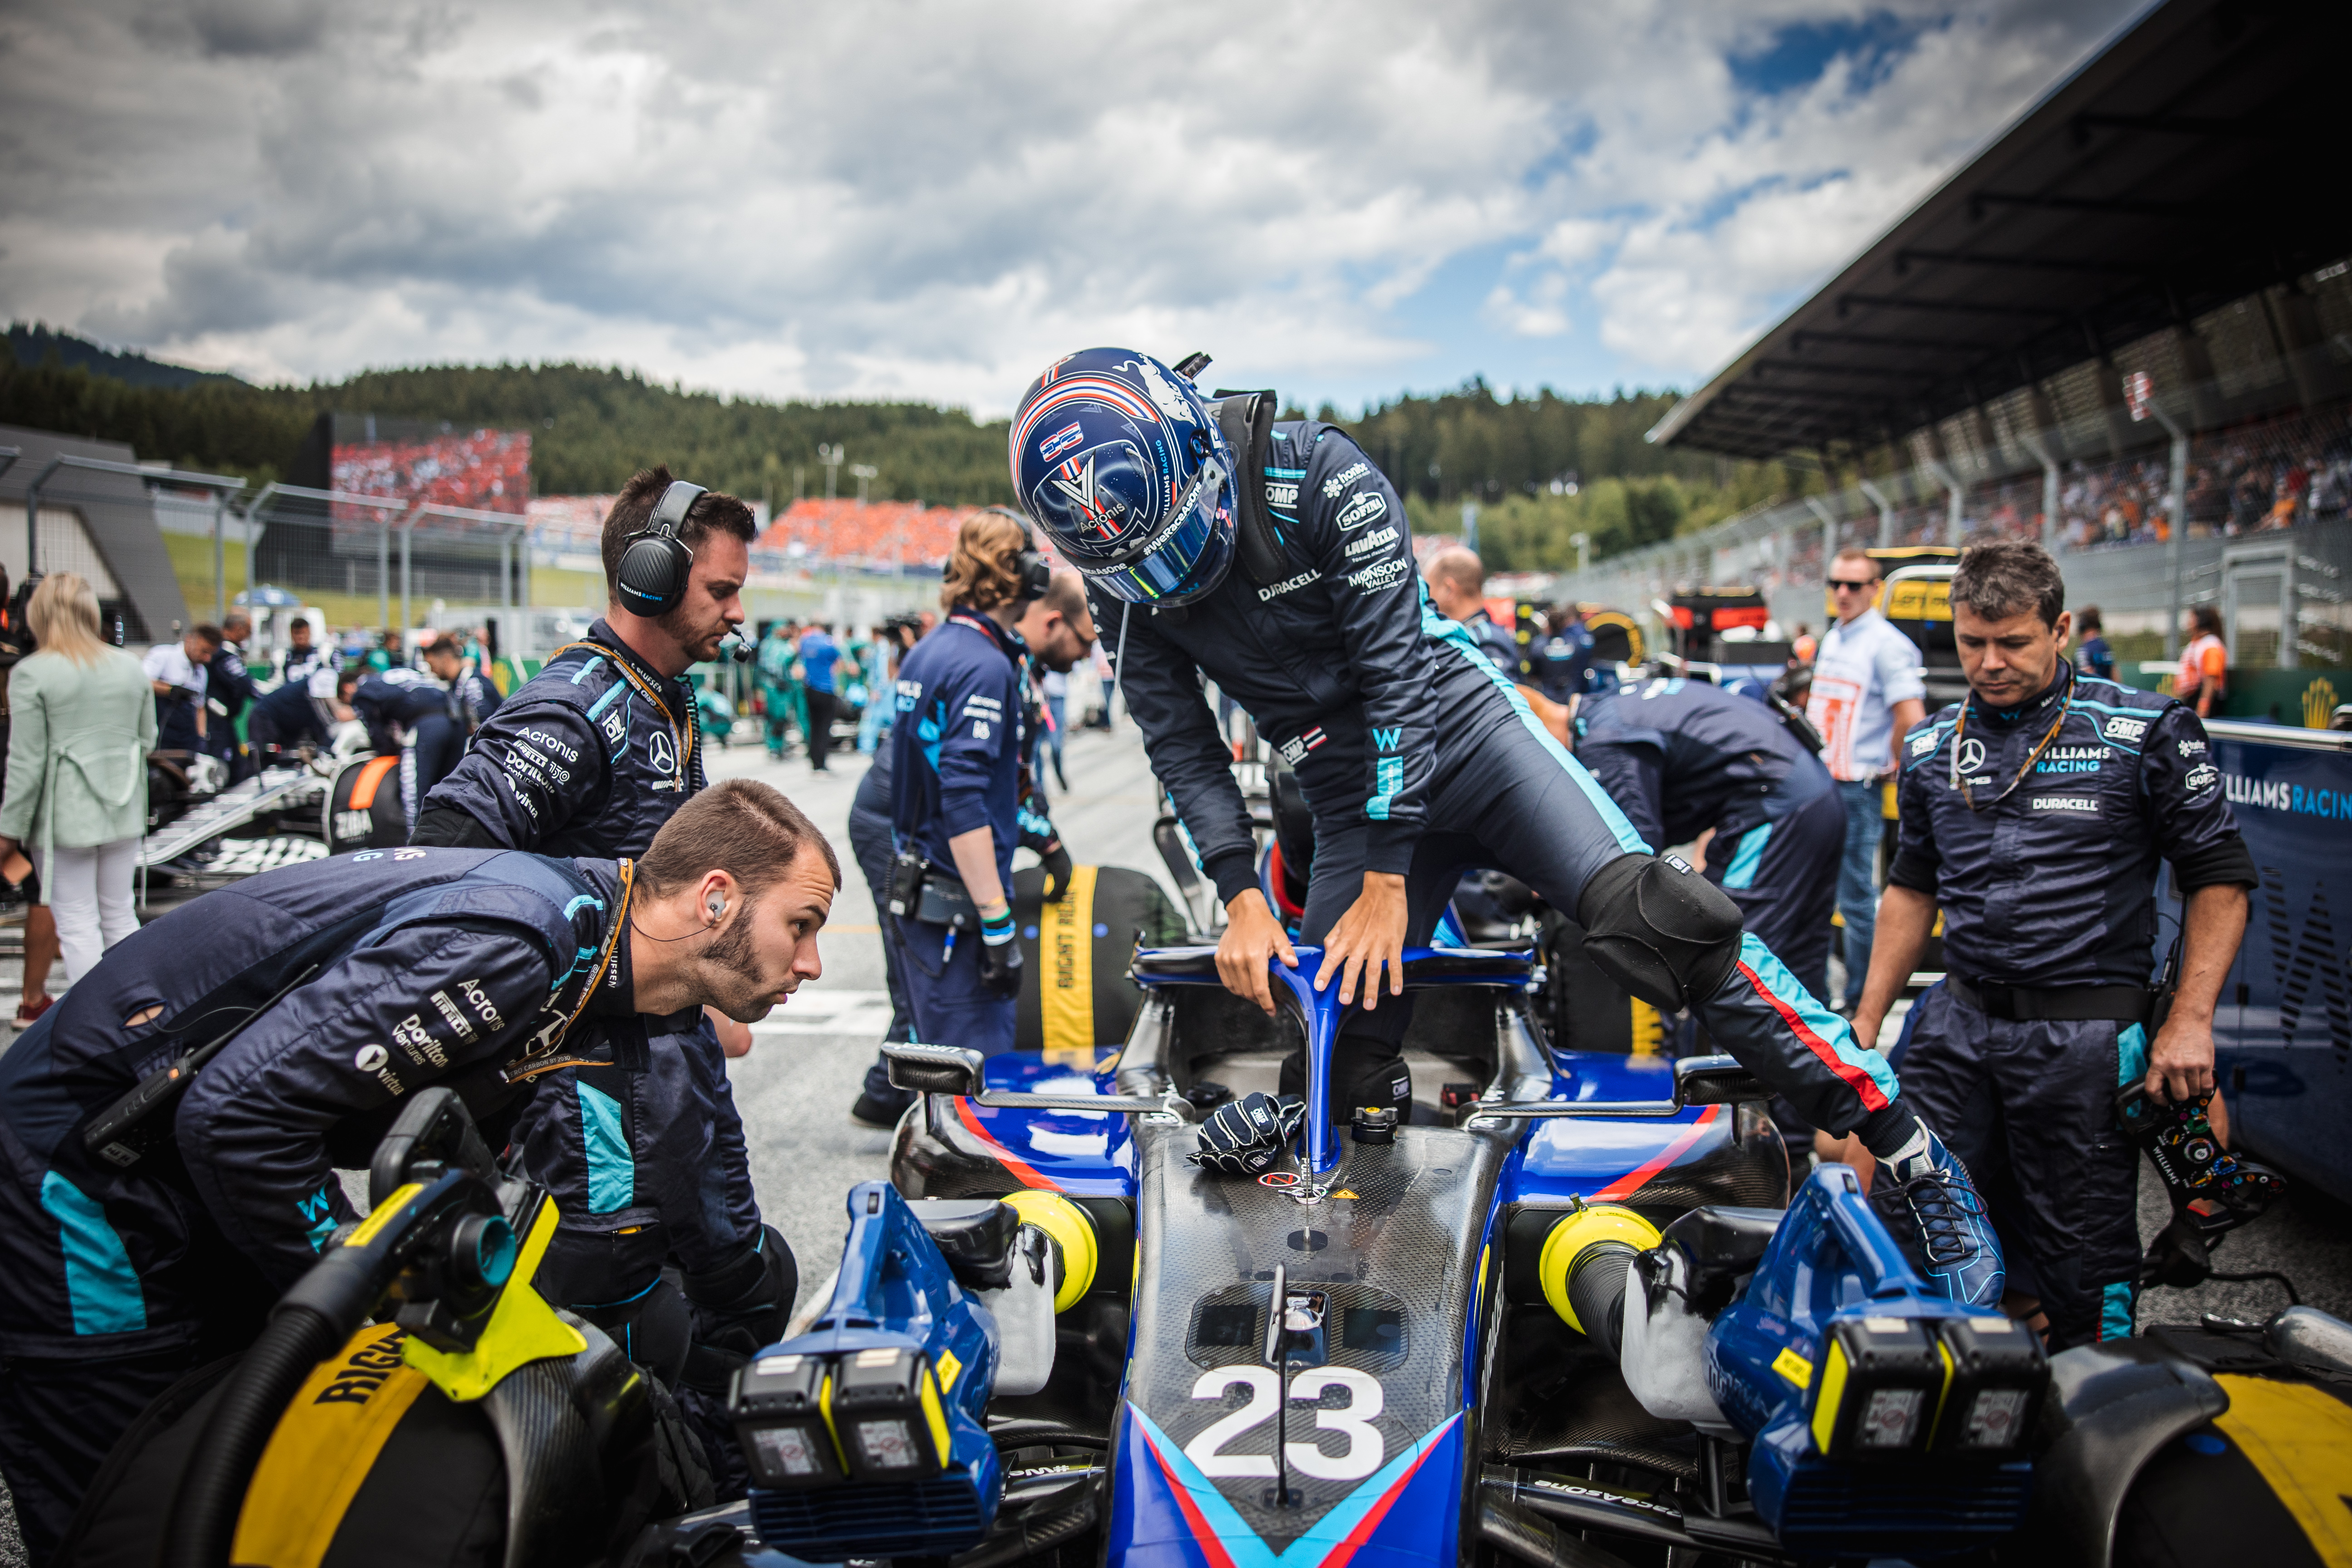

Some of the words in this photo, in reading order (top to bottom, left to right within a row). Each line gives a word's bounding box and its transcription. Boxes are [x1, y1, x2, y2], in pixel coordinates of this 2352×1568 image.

[1039, 419, 1084, 463] 23
[1155, 439, 1169, 474] RACING
[1265, 487, 1298, 504] OMP
[1080, 503, 1126, 534] Acronis
[1143, 481, 1202, 556] #WeRaceAsOne
[621, 582, 642, 597] WILLIAMS
[642, 592, 662, 601] RACING
[1365, 573, 1396, 590] VALLEY
[1382, 581, 1399, 591] JUICE
[636, 666, 662, 693] OLUFSEN
[640, 690, 656, 707] GRID
[1372, 727, 1402, 752] W
[2105, 720, 2146, 738] OMP
[513, 739, 549, 768] PIRELLI
[515, 726, 579, 763] Acronis
[1282, 740, 1305, 762] OMP
[548, 761, 570, 782] 150
[2036, 760, 2101, 773] RACING
[2032, 798, 2099, 811] DURACELL
[1058, 934, 1074, 989] RIGHT
[584, 964, 600, 990] 2022
[429, 990, 473, 1037] PIRELLI
[457, 978, 505, 1031] Acronis
[391, 1024, 426, 1065] Ventures
[401, 1013, 449, 1068] Dorilton
[508, 1068, 523, 1079] ZERO
[523, 1060, 549, 1071] CARBON
[1252, 1108, 1267, 1124] OMP
[1252, 1156, 1267, 1166] OMP
[1301, 1157, 1311, 1180] PULL
[2152, 1146, 2179, 1185] WILLIAMS
[1481, 1260, 1504, 1436] DURACELL
[1184, 1365, 1385, 1481] 23
